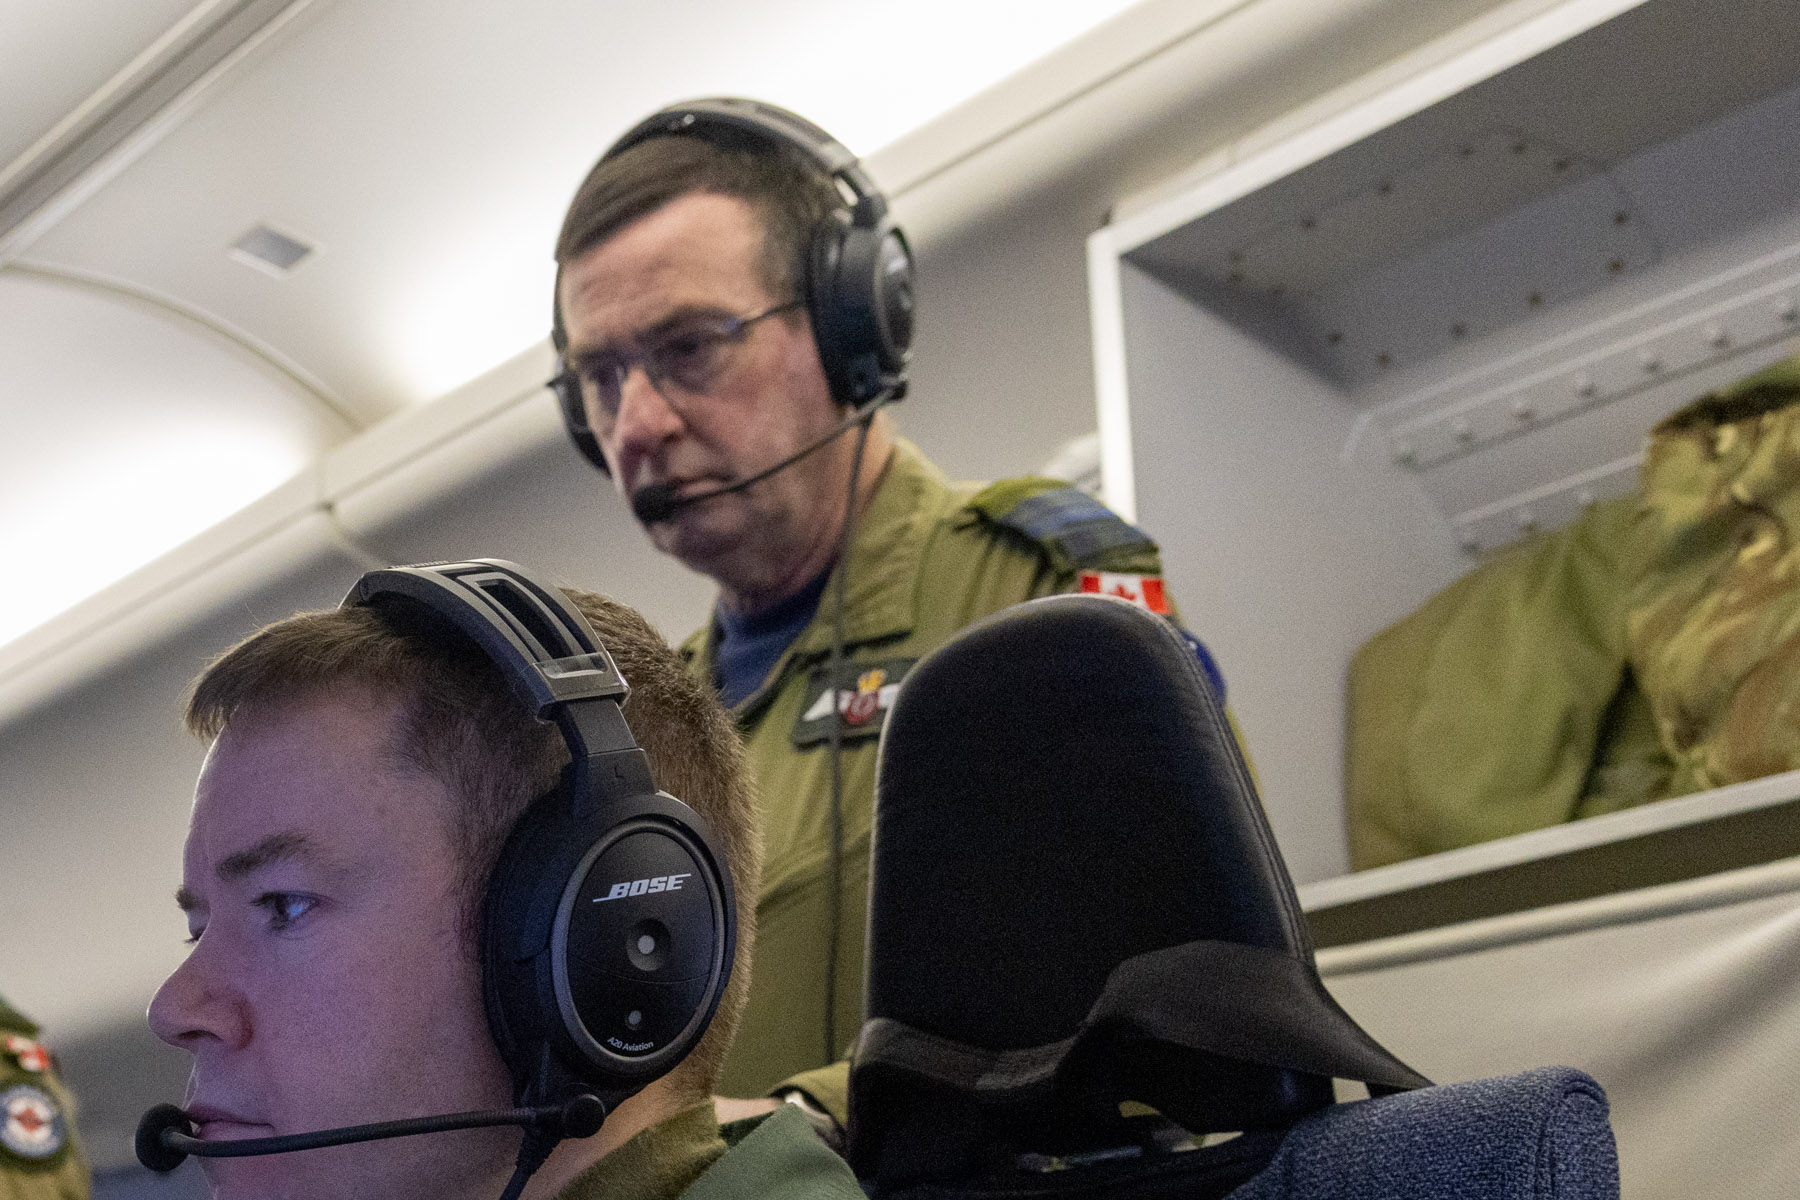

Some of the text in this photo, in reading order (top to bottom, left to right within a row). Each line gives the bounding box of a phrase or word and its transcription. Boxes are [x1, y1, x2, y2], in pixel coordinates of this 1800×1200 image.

[592, 873, 692, 903] BOSE
[606, 1035, 655, 1052] A20 Aviation
